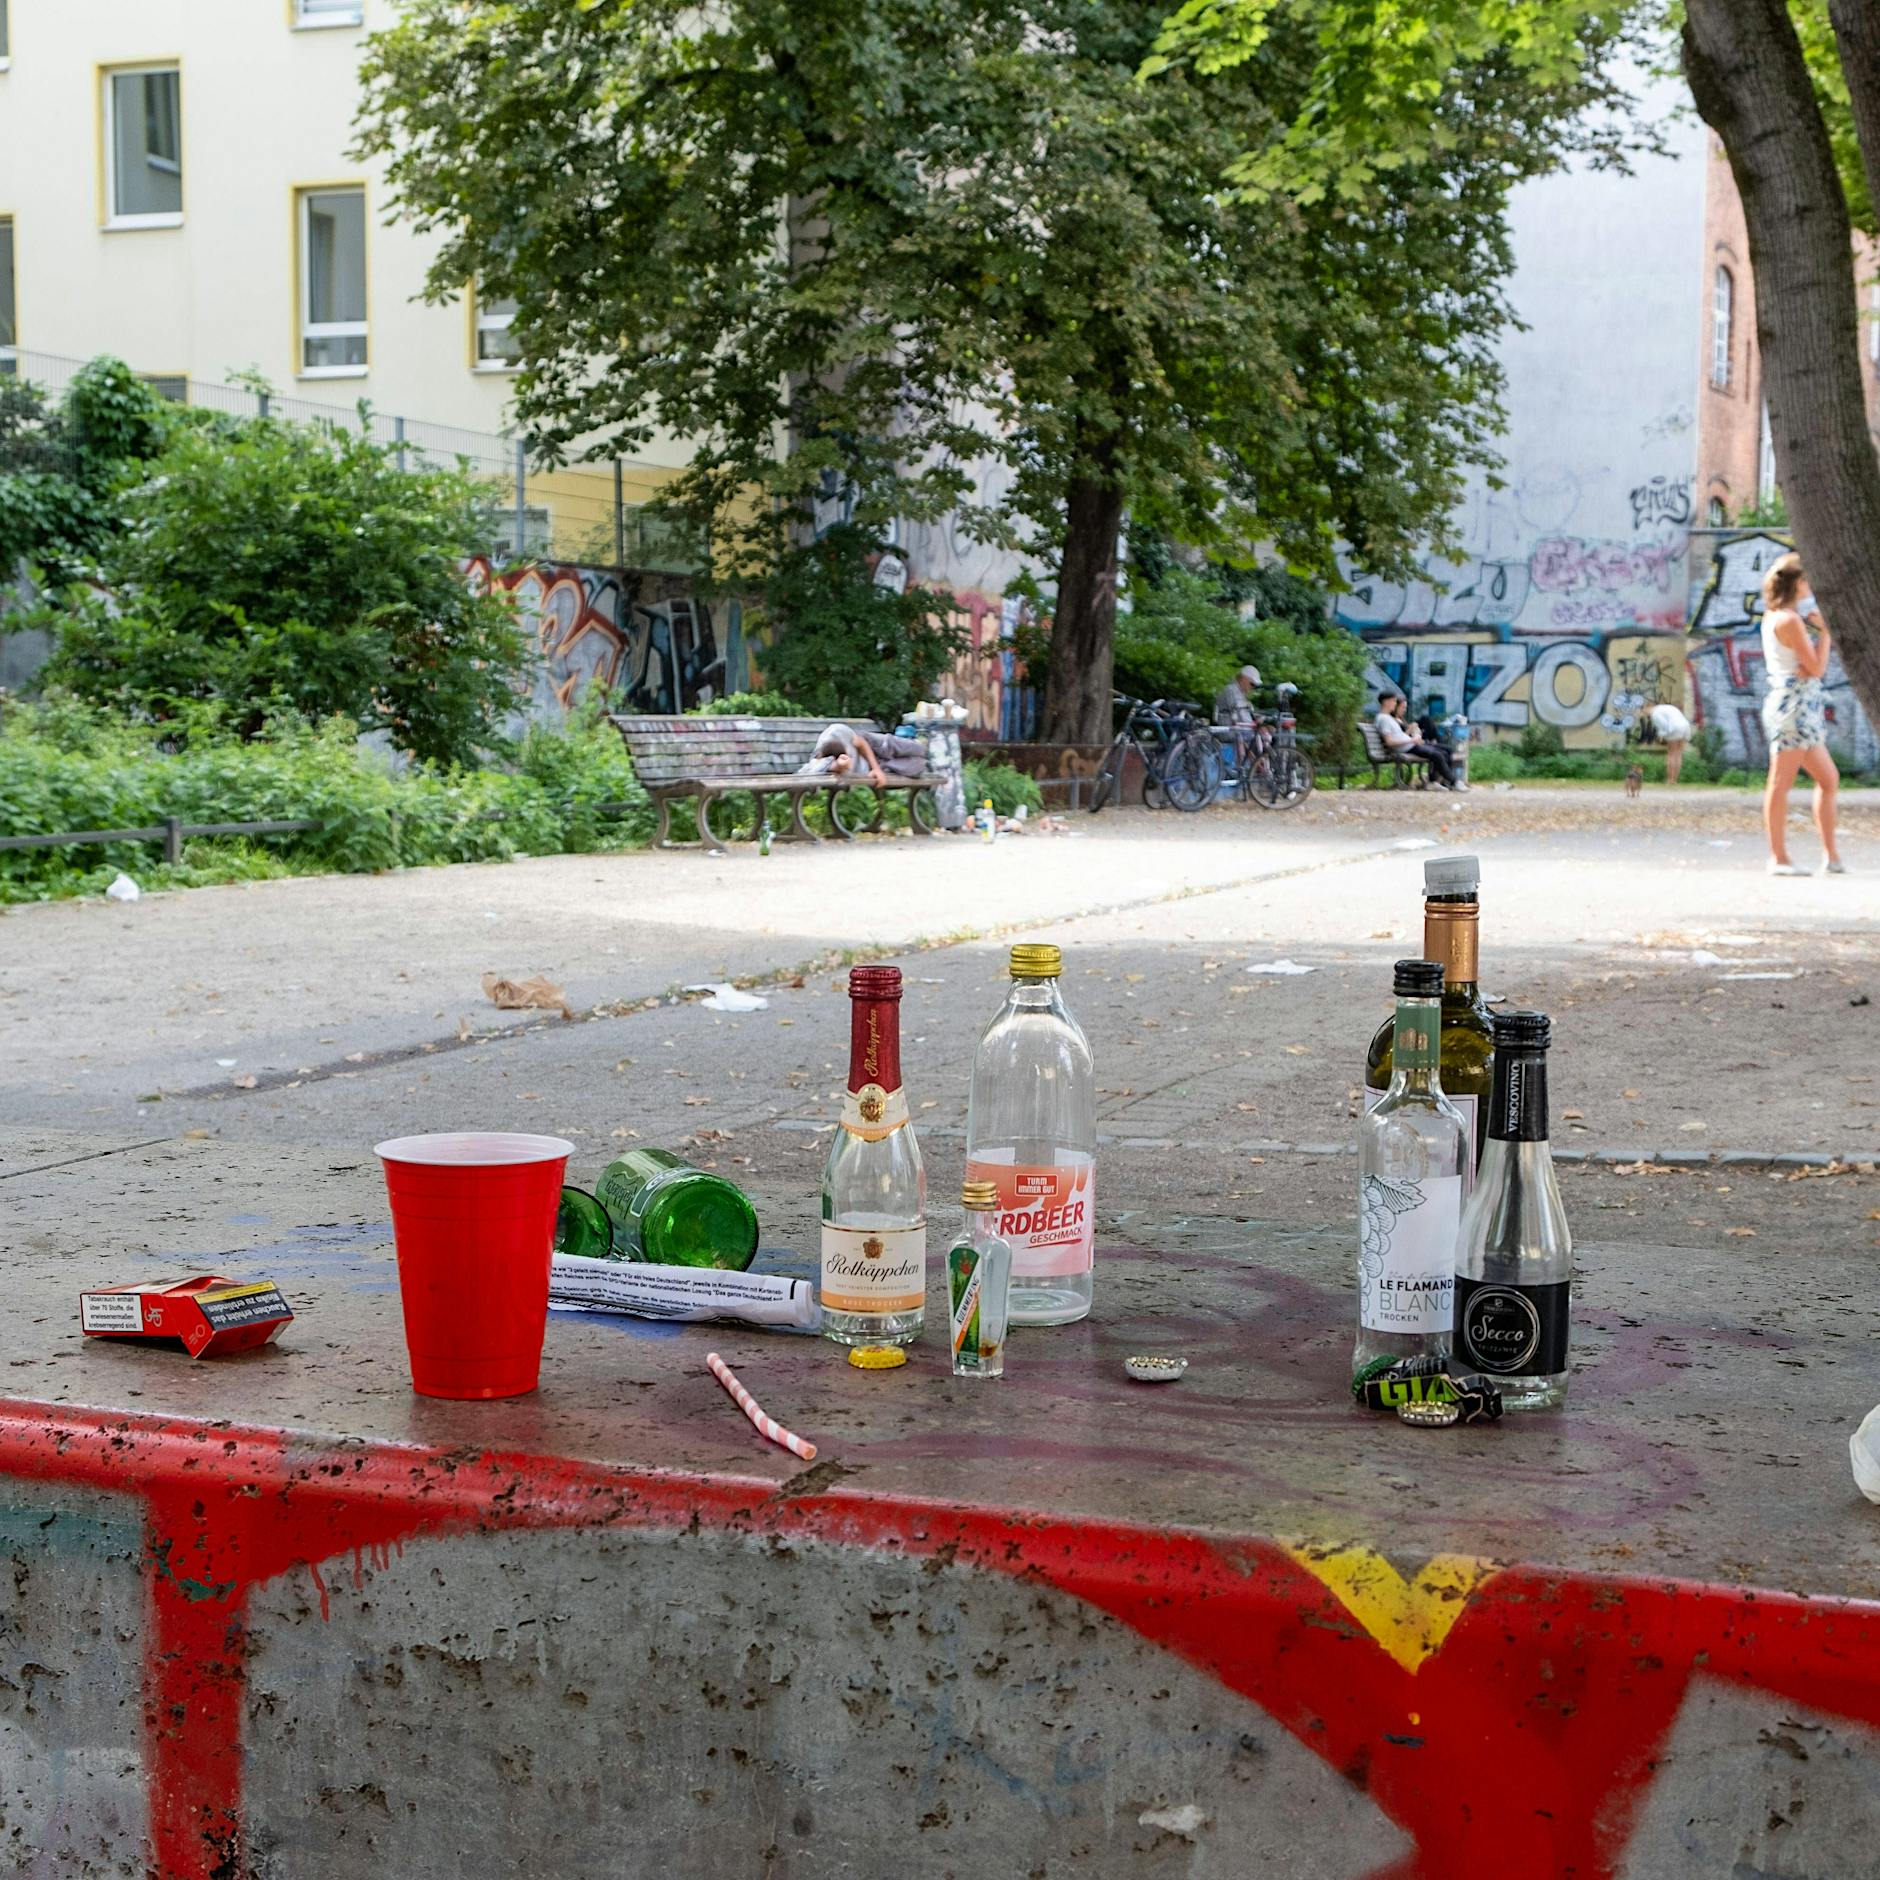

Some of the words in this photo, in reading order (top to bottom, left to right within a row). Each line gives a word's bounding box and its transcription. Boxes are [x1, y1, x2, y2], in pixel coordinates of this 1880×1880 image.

[1508, 1063, 1521, 1132] VESCOVINO
[1027, 1177, 1047, 1185] TURM
[1030, 1227, 1082, 1244] GESCHMACK
[826, 1253, 919, 1282] Rotkäppchen
[1380, 1279, 1393, 1291] LE
[1397, 1279, 1453, 1291] FLAMAND
[252, 1302, 287, 1315] Rauchen
[1380, 1291, 1451, 1312] BLANC
[211, 1315, 224, 1324] das
[1380, 1312, 1419, 1322] TROCKEN
[1471, 1315, 1525, 1342] Secco
